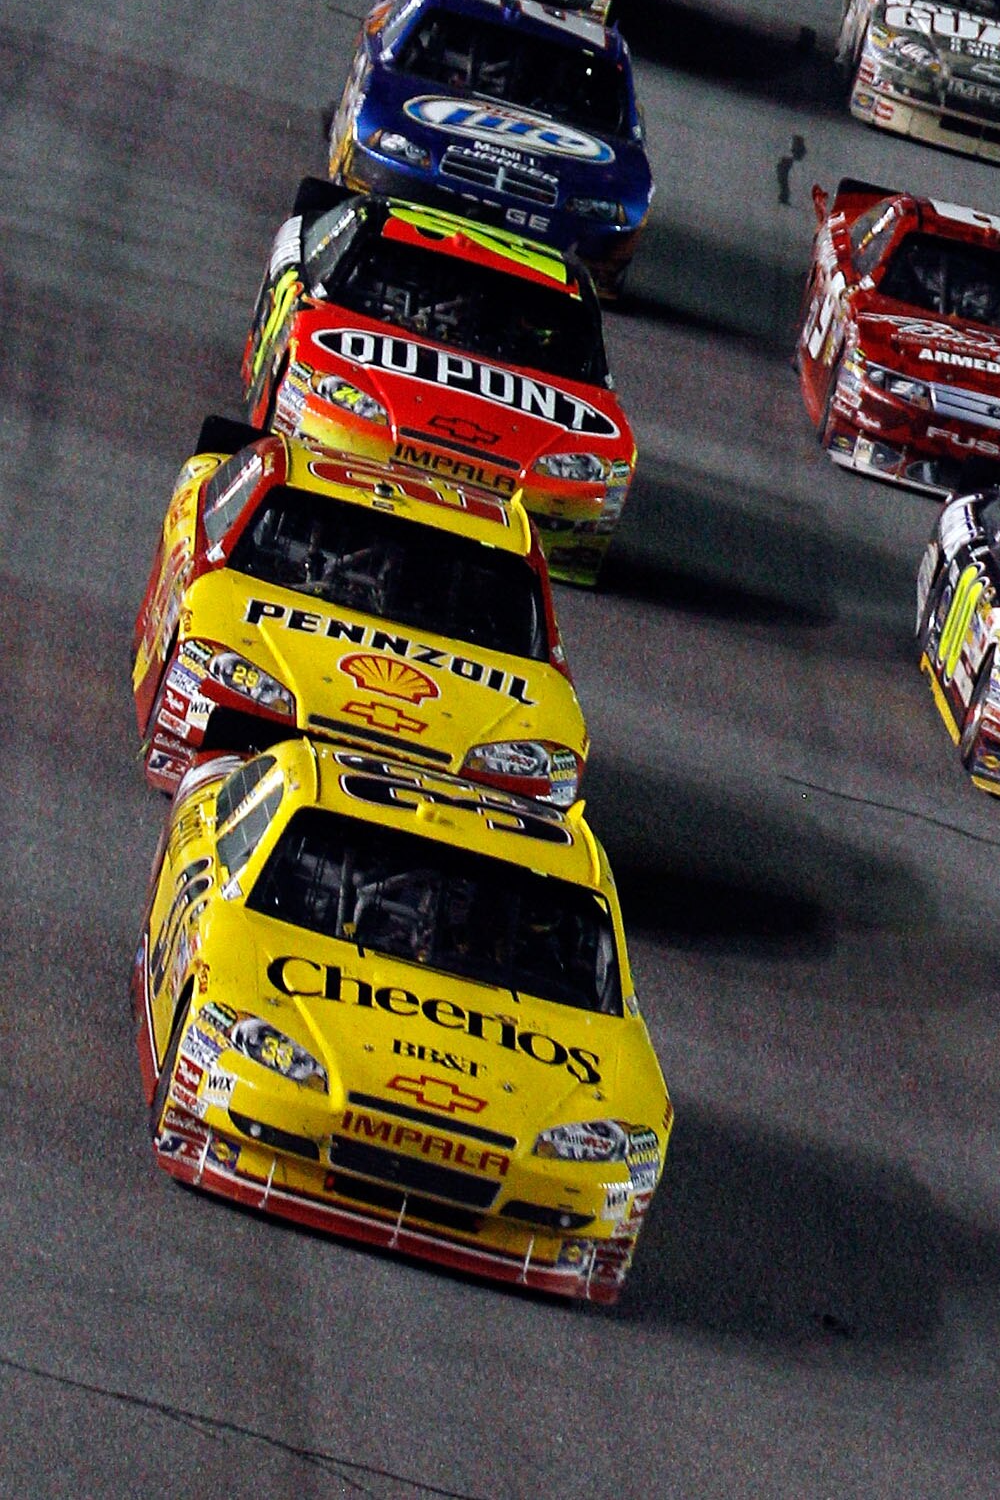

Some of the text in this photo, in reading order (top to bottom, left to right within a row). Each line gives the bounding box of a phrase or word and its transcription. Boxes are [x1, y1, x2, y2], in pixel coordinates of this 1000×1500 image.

[446, 144, 560, 184] CHARGER
[473, 140, 521, 161] Mobil
[918, 348, 1000, 374] ARMED
[394, 443, 518, 492] IMPALA
[246, 598, 538, 707] PENNZOIL
[232, 665, 260, 688] 29
[189, 701, 212, 715] WIX
[266, 955, 602, 1084] Cheerios
[393, 1038, 488, 1078] BB&T
[207, 1074, 234, 1092] WIX
[341, 1110, 511, 1178] IMPALA
